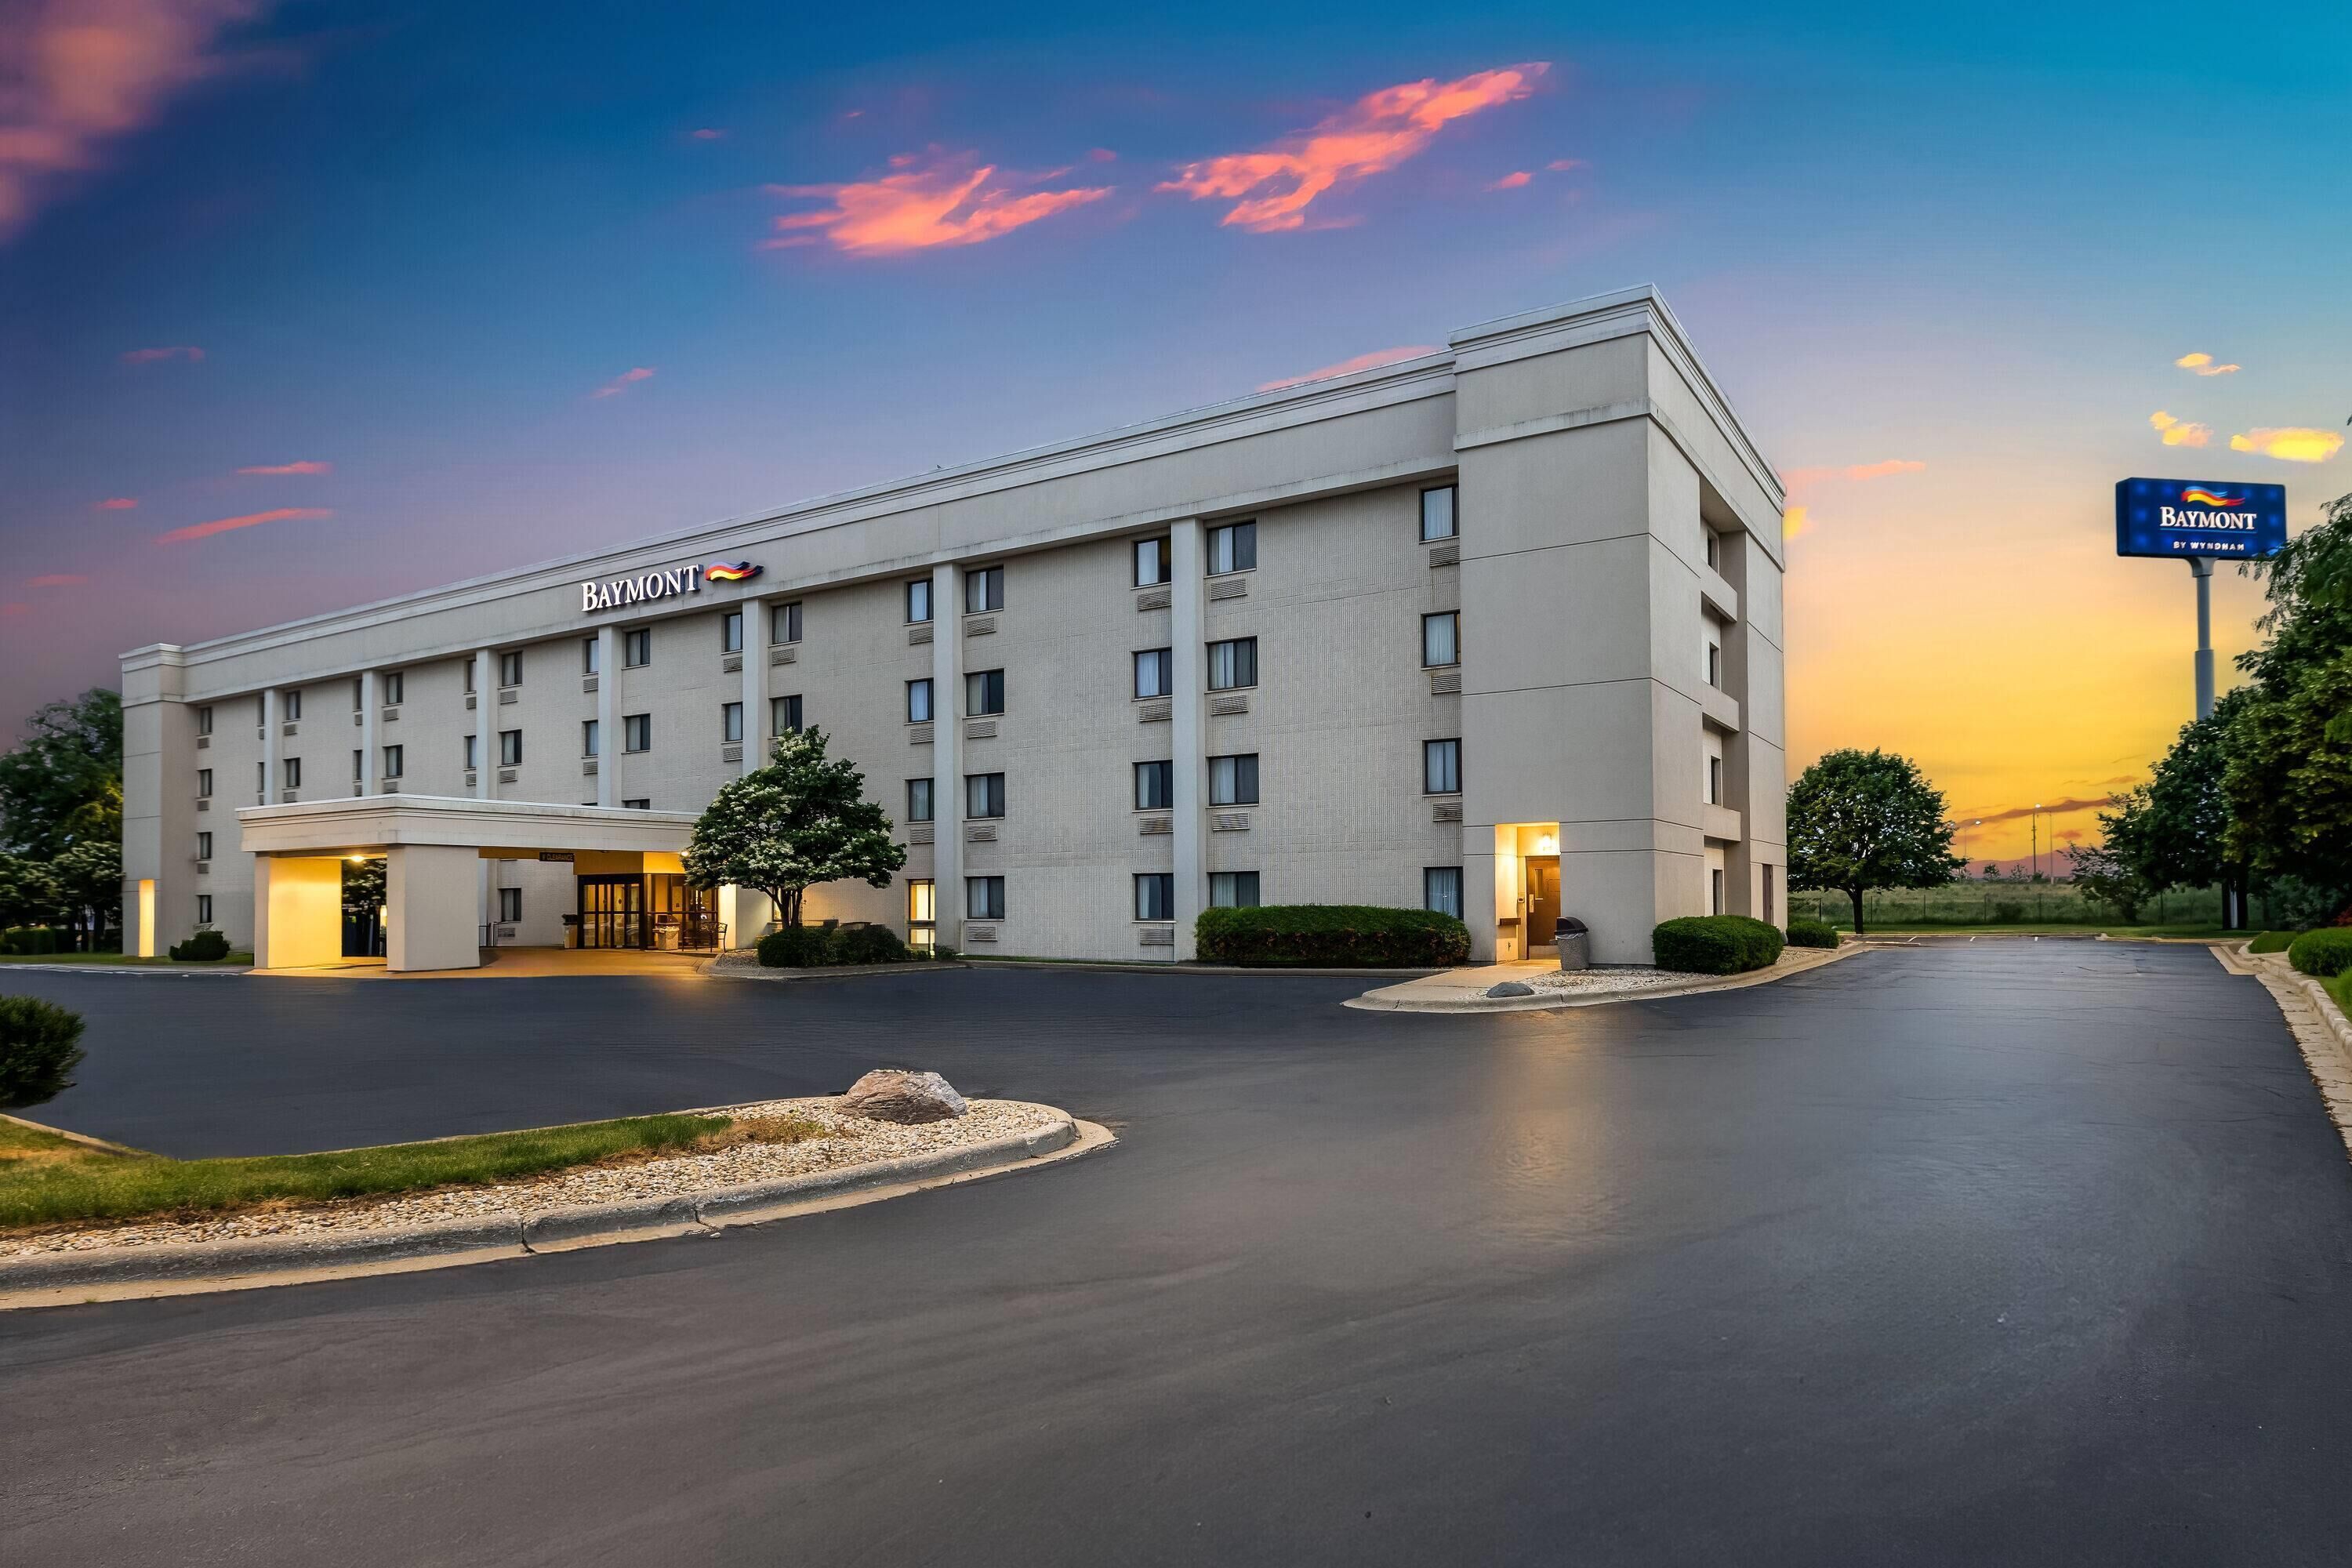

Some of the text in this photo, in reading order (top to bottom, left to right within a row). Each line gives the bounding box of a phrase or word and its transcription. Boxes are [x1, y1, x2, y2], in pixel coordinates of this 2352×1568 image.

[2160, 506, 2256, 530] BAYMONT
[2190, 542, 2245, 550] WYNDHAM
[581, 564, 702, 612] BAYMONT
